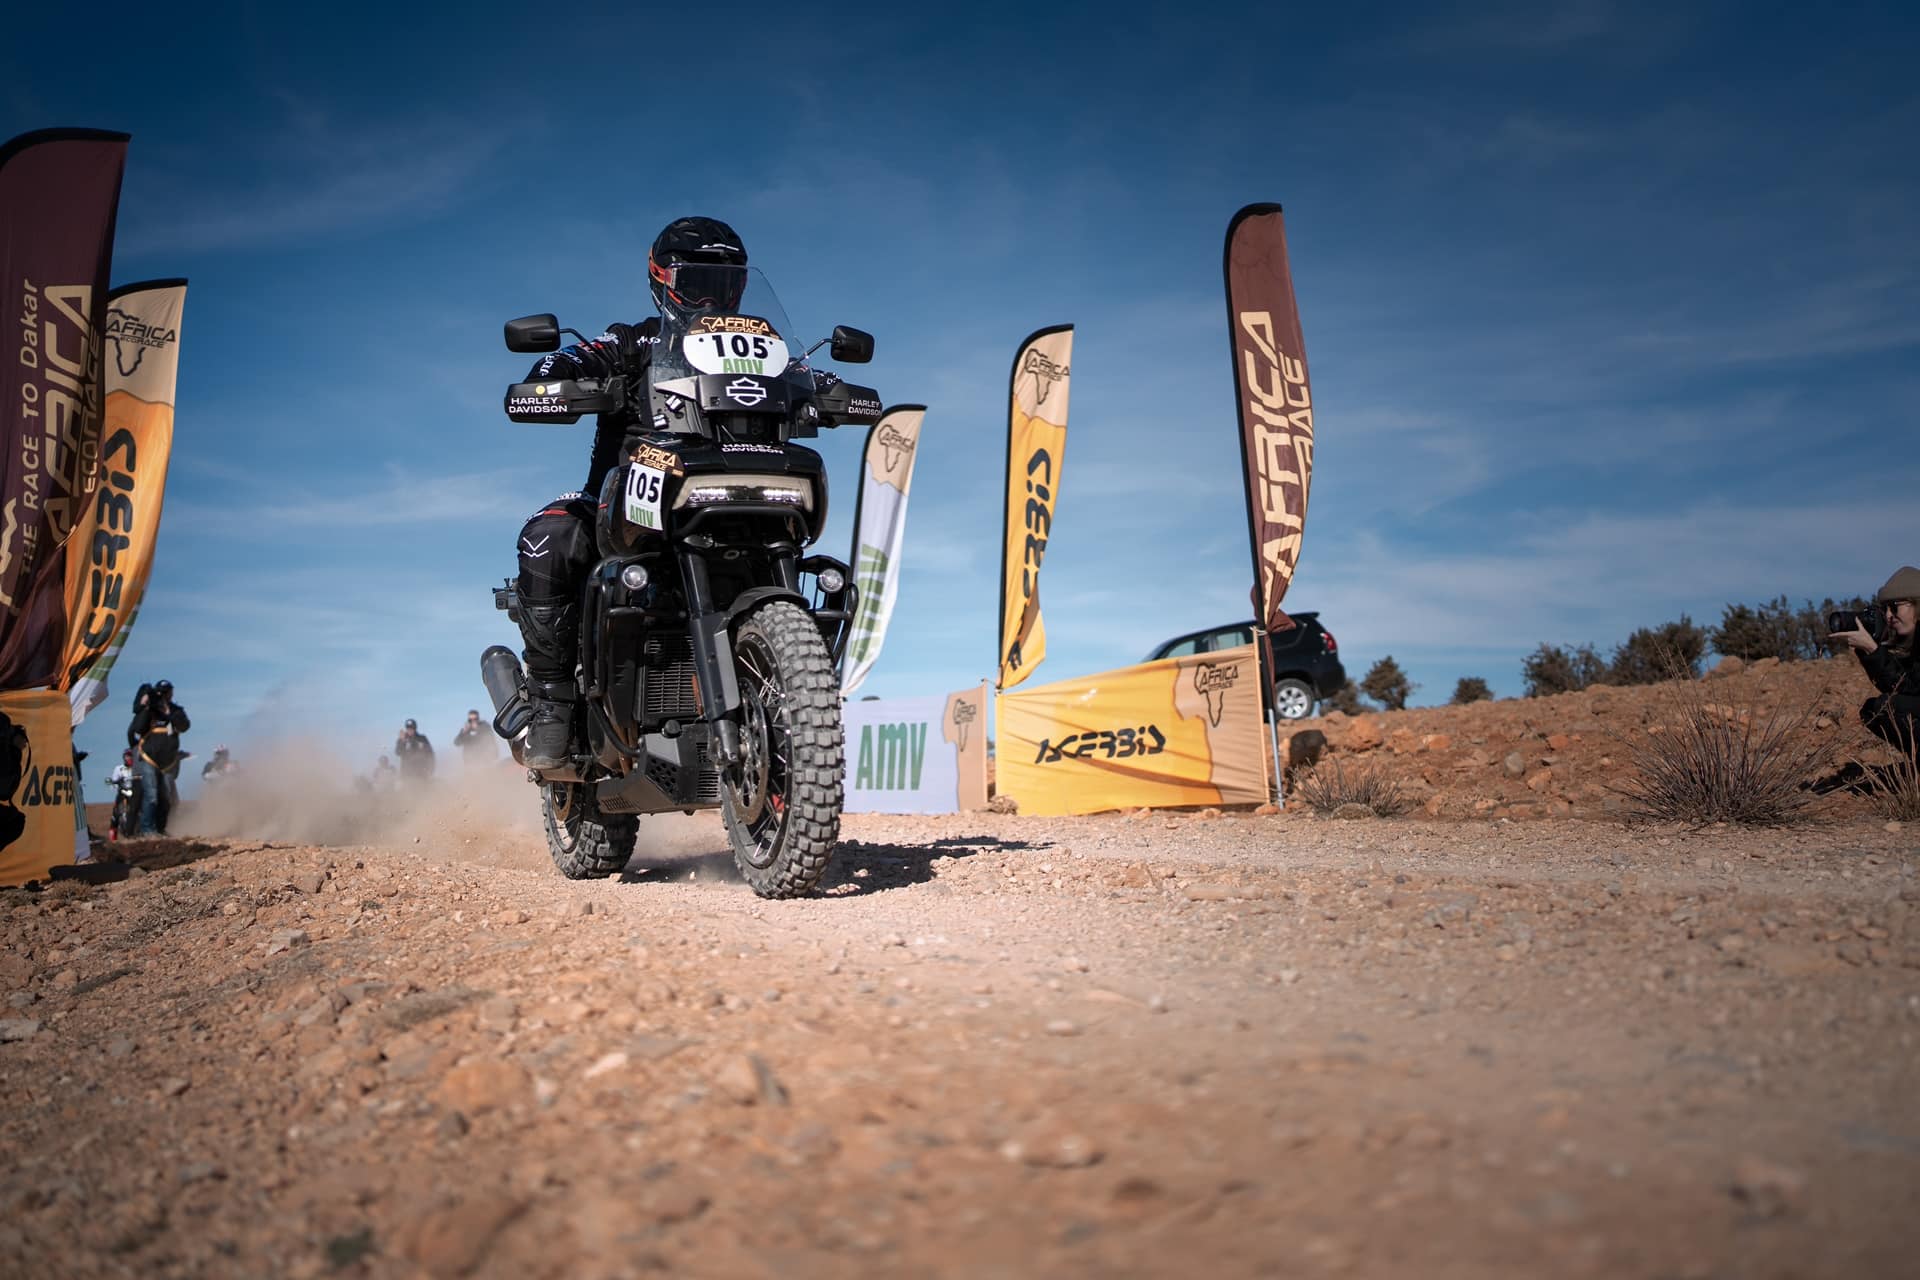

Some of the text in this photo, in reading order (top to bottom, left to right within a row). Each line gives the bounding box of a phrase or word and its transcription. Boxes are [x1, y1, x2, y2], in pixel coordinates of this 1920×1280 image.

[20, 279, 38, 368] Dakar
[107, 319, 176, 342] AFRICA
[711, 316, 770, 332] AFRICA
[712, 334, 769, 360] 105
[21, 382, 39, 418] TO
[508, 405, 568, 414] DAVIDSON
[850, 399, 881, 408] HARLEY
[21, 435, 39, 510] RACE
[628, 468, 661, 503] 105
